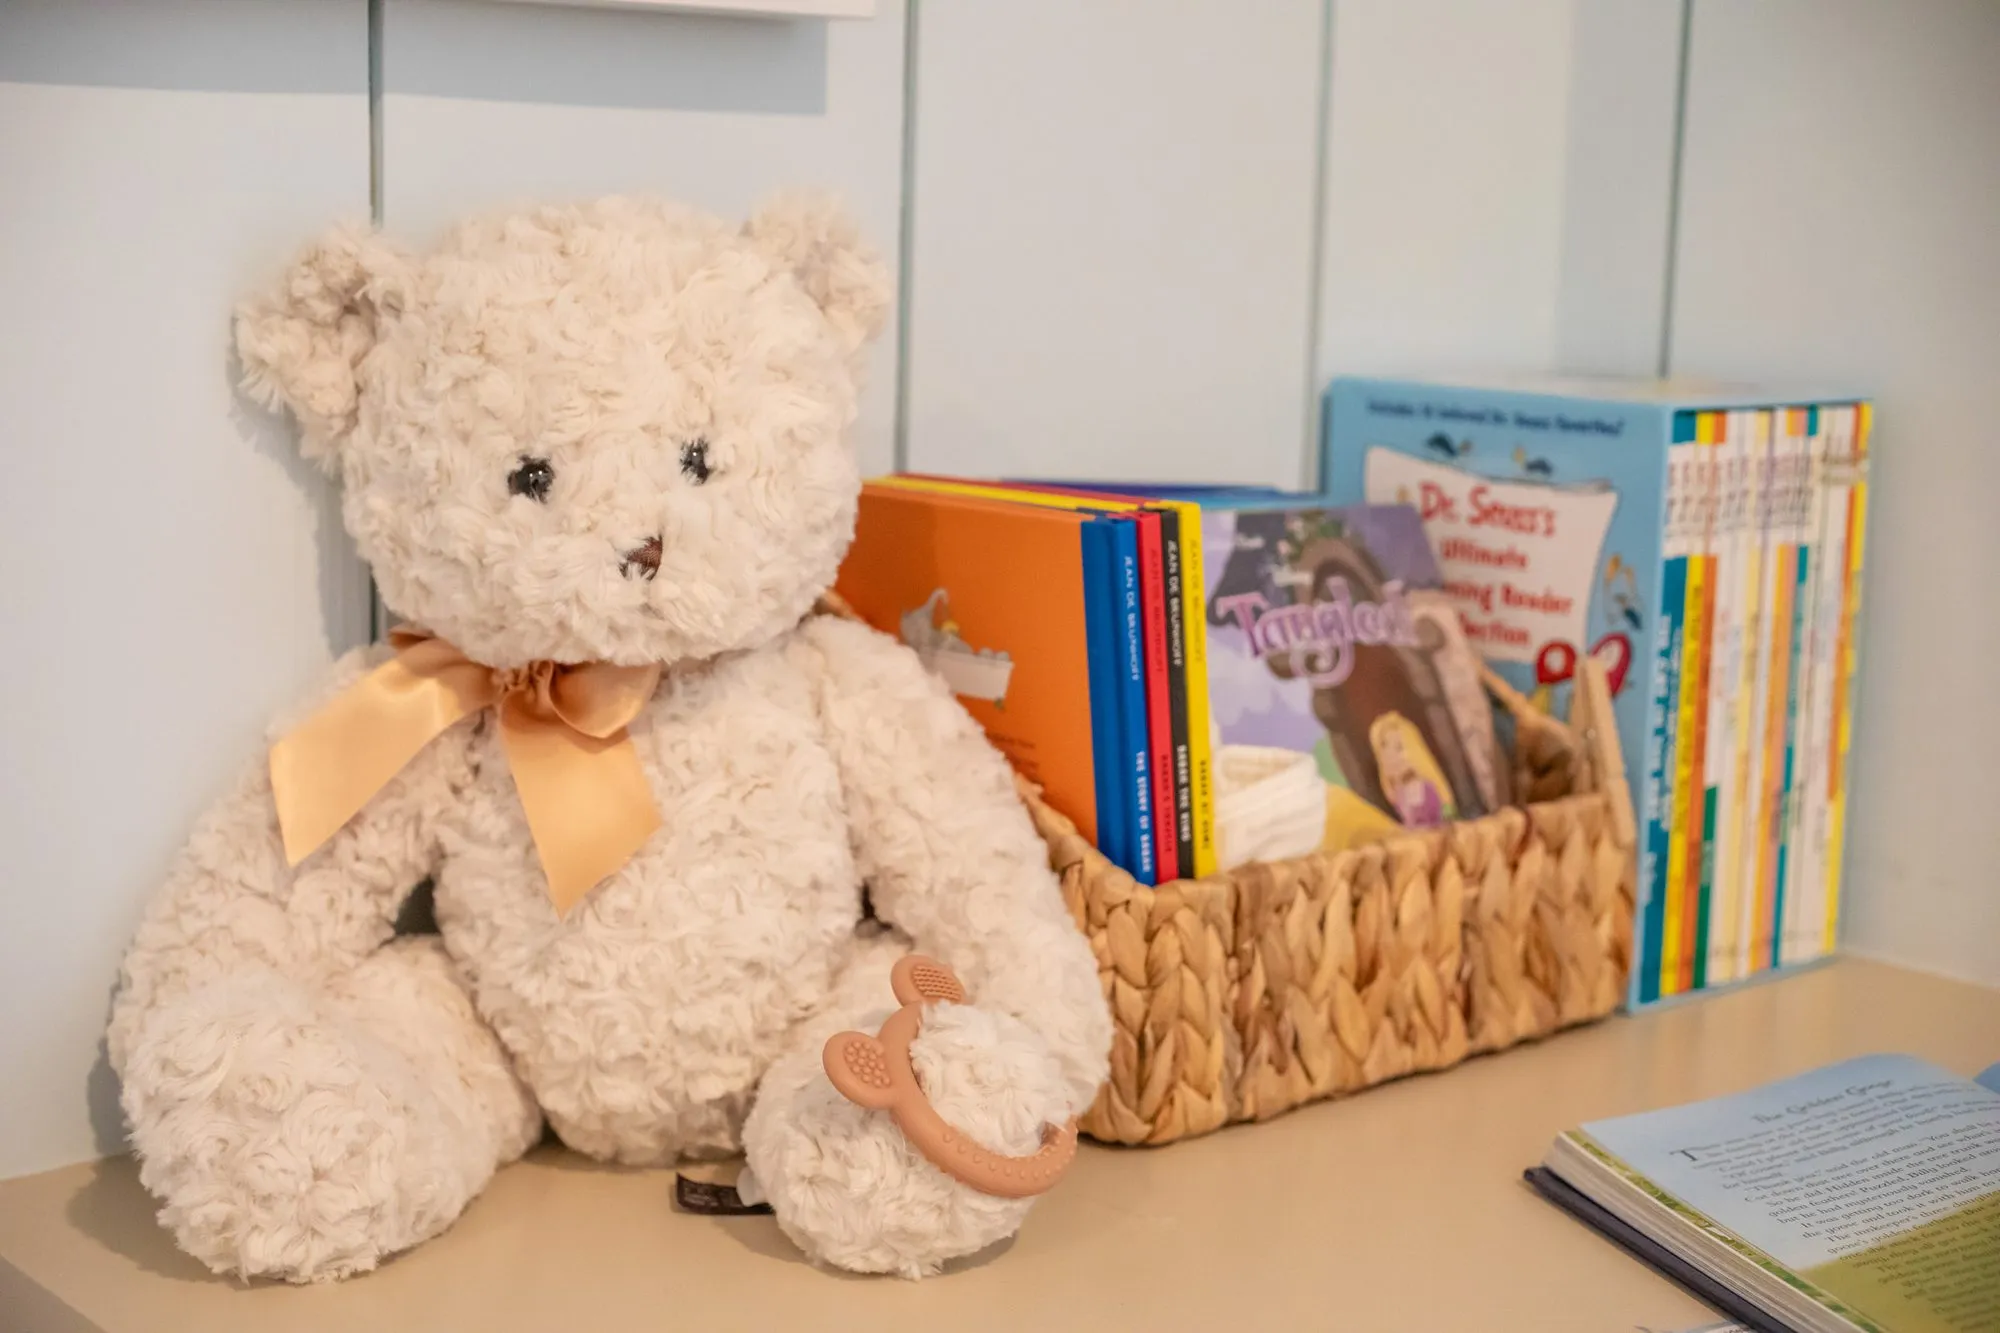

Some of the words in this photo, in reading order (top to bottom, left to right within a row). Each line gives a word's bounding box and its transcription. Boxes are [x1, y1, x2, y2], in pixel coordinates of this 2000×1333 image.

[1418, 480, 1459, 522] Dr.
[1167, 540, 1179, 573] JEAN
[1440, 535, 1529, 569] Ultimate
[1124, 556, 1133, 588] JEAN
[1169, 576, 1180, 595] DE
[1126, 591, 1136, 609] DE
[1500, 581, 1572, 614] Reader
[1127, 613, 1140, 681] BRUNHOFF
[1170, 597, 1183, 666] BRUNHOFF
[1135, 751, 1146, 772] THE
[1177, 744, 1189, 784] BABAR
[1137, 776, 1149, 811] STORY
[1179, 787, 1190, 809] THE
[1139, 815, 1150, 829] OF
[1181, 812, 1192, 842] KING
[1141, 834, 1152, 873] BABAR
[1768, 1205, 1808, 1216] golden
[1907, 1168, 1938, 1178] Billy
[1935, 1154, 1976, 1168] looked
[1770, 1187, 1803, 1196] down
[1805, 1179, 1829, 1188] that
[1855, 1164, 1879, 1174] over
[1881, 1156, 1909, 1165] there
[1912, 1146, 1935, 1155] and
[1825, 1178, 1869, 1192] Hidden
[1871, 1168, 1903, 1179] inside
[1926, 1153, 1948, 1161] tree
[1950, 1143, 1981, 1154] trunk
[1816, 1204, 1842, 1214] had
[1844, 1185, 1917, 1207] mysteriously
[1824, 1222, 1857, 1234] goose
[1861, 1213, 1884, 1223] and
[1885, 1206, 1914, 1216] took
[1927, 1194, 1954, 1203] with
[1954, 1186, 1980, 1195] him
[1841, 1206, 1883, 1219] getting
[1906, 1190, 1933, 1199] dark
[1950, 1175, 1978, 1185] walk
[1826, 1234, 1850, 1242] The
[1853, 1216, 1917, 1235] innkeeper's
[1919, 1207, 1946, 1217] three
